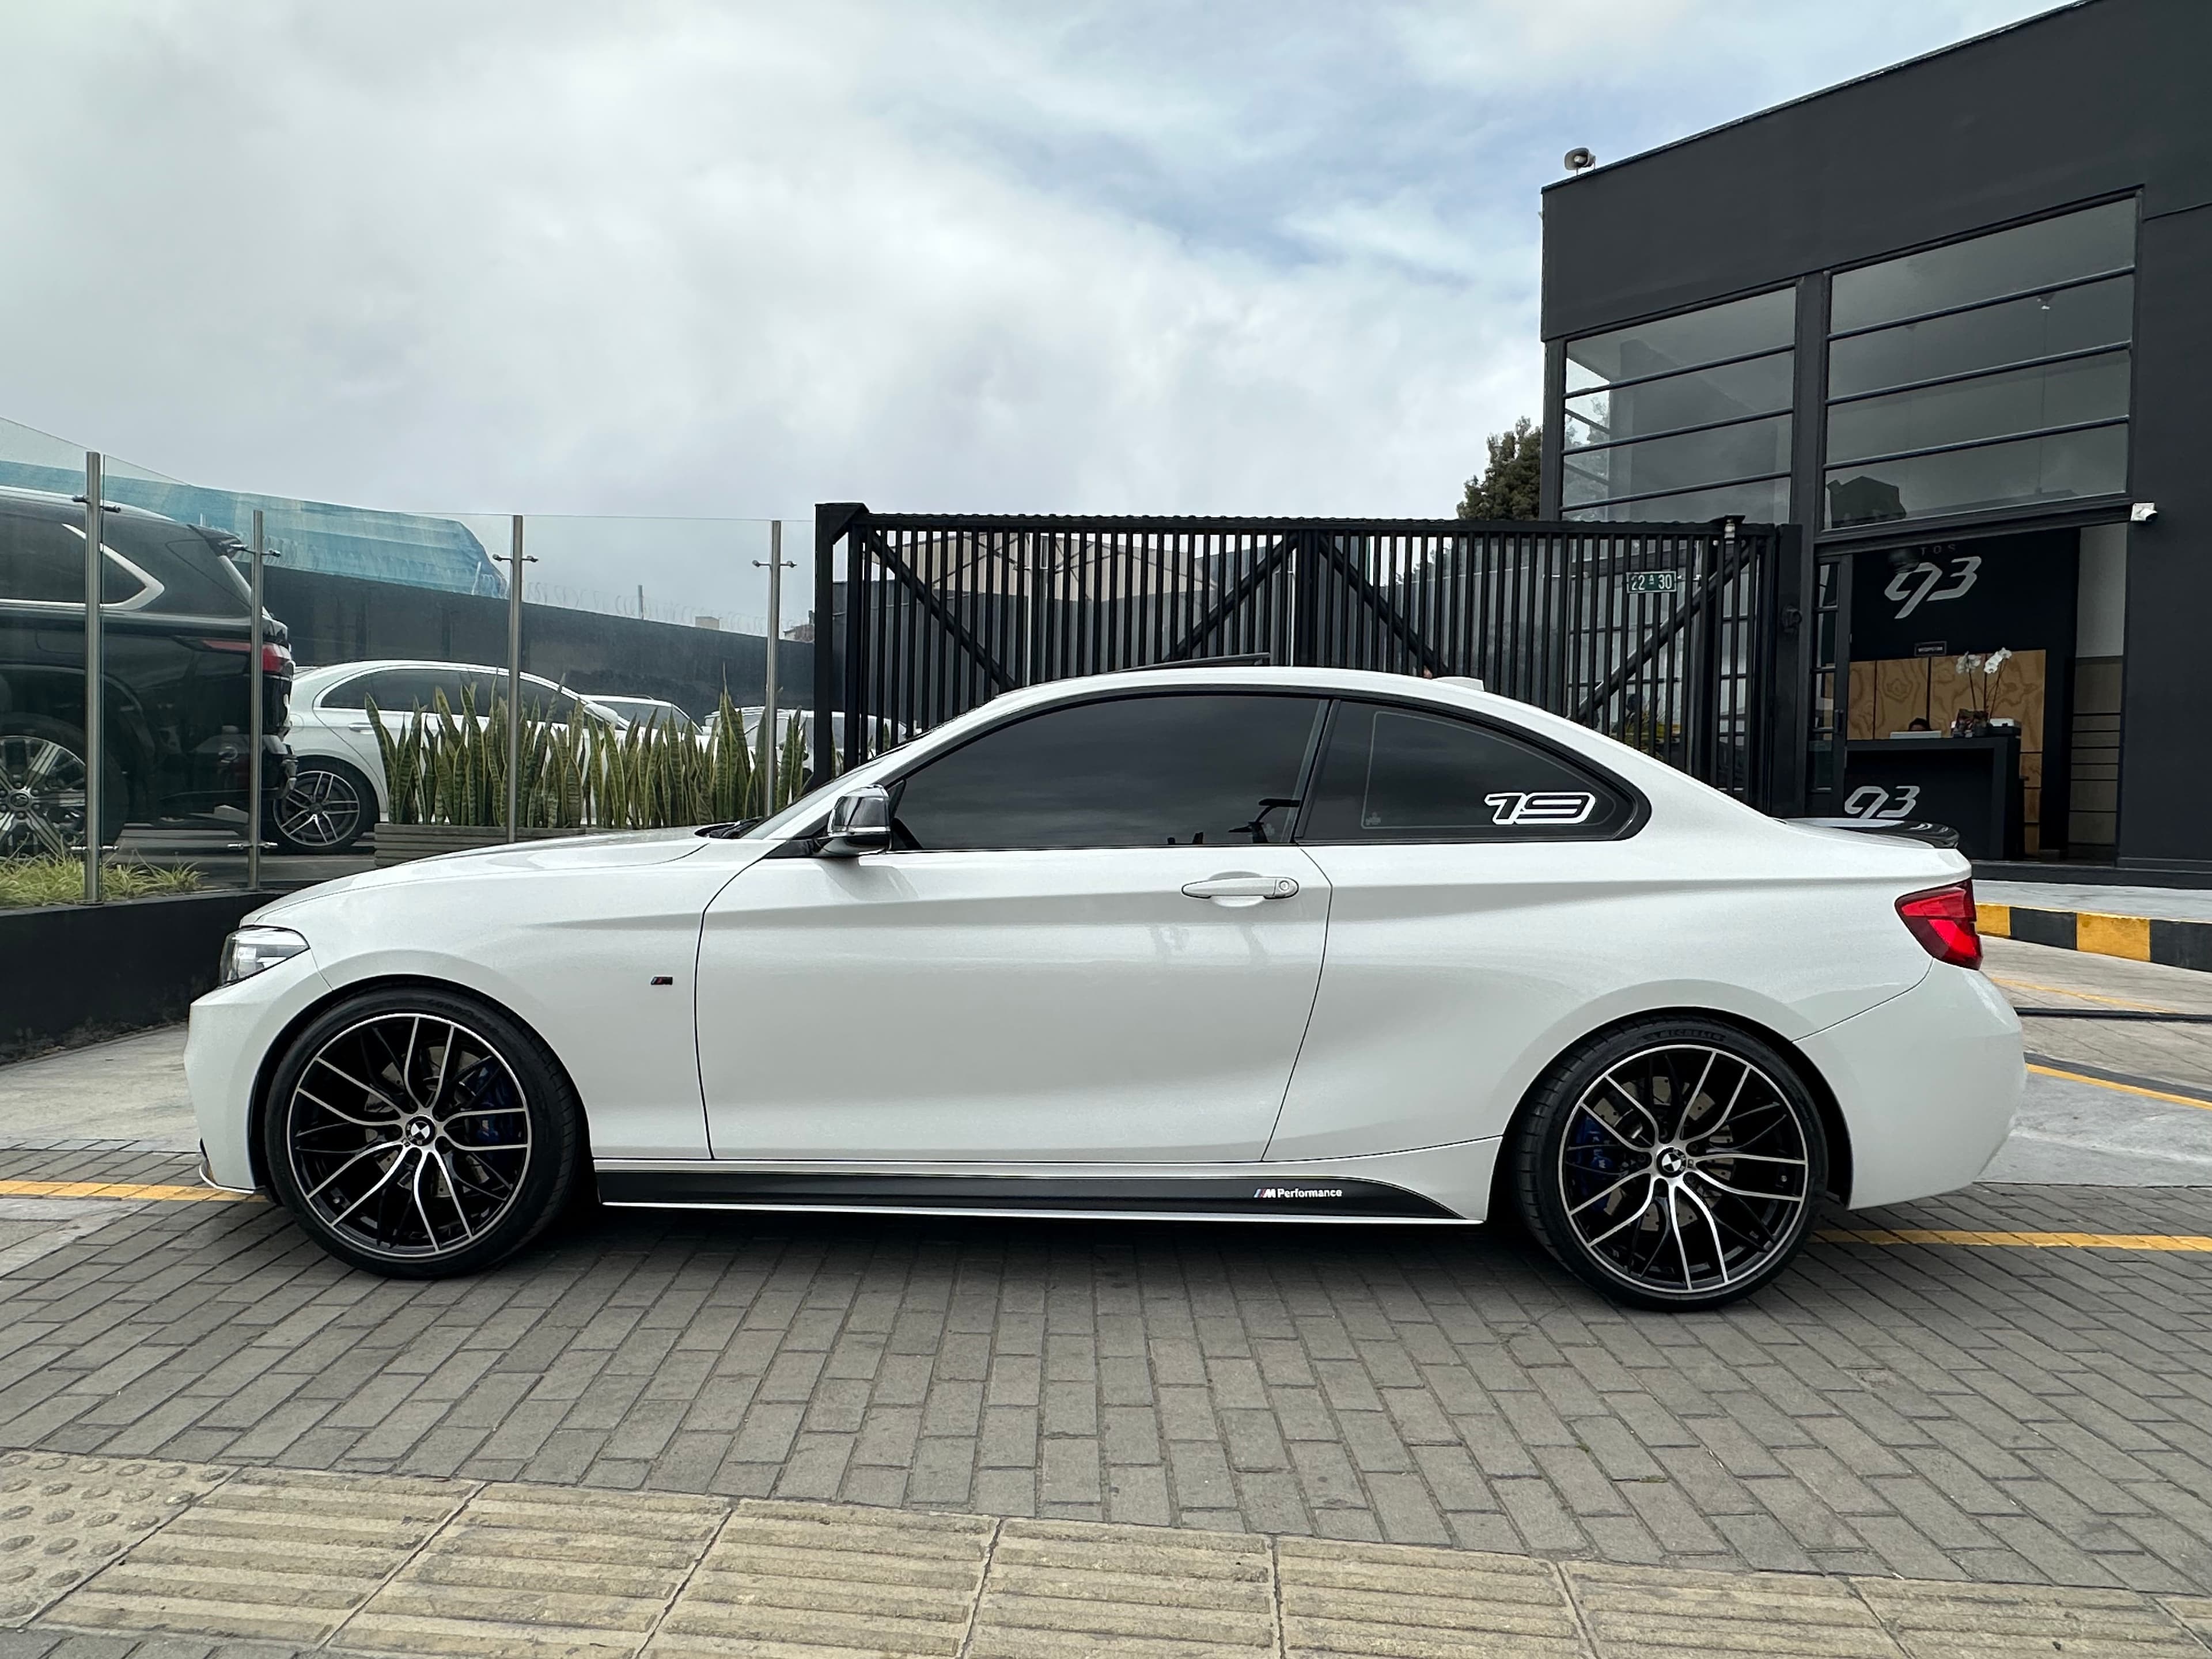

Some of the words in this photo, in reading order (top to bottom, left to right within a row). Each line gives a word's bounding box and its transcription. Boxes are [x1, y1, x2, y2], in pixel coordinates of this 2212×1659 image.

[1631, 575, 1646, 590] 22
[1658, 574, 1672, 589] 30
[1884, 556, 1982, 619] 93
[1844, 786, 1920, 819] 93
[1278, 1188, 1342, 1198] Performance
